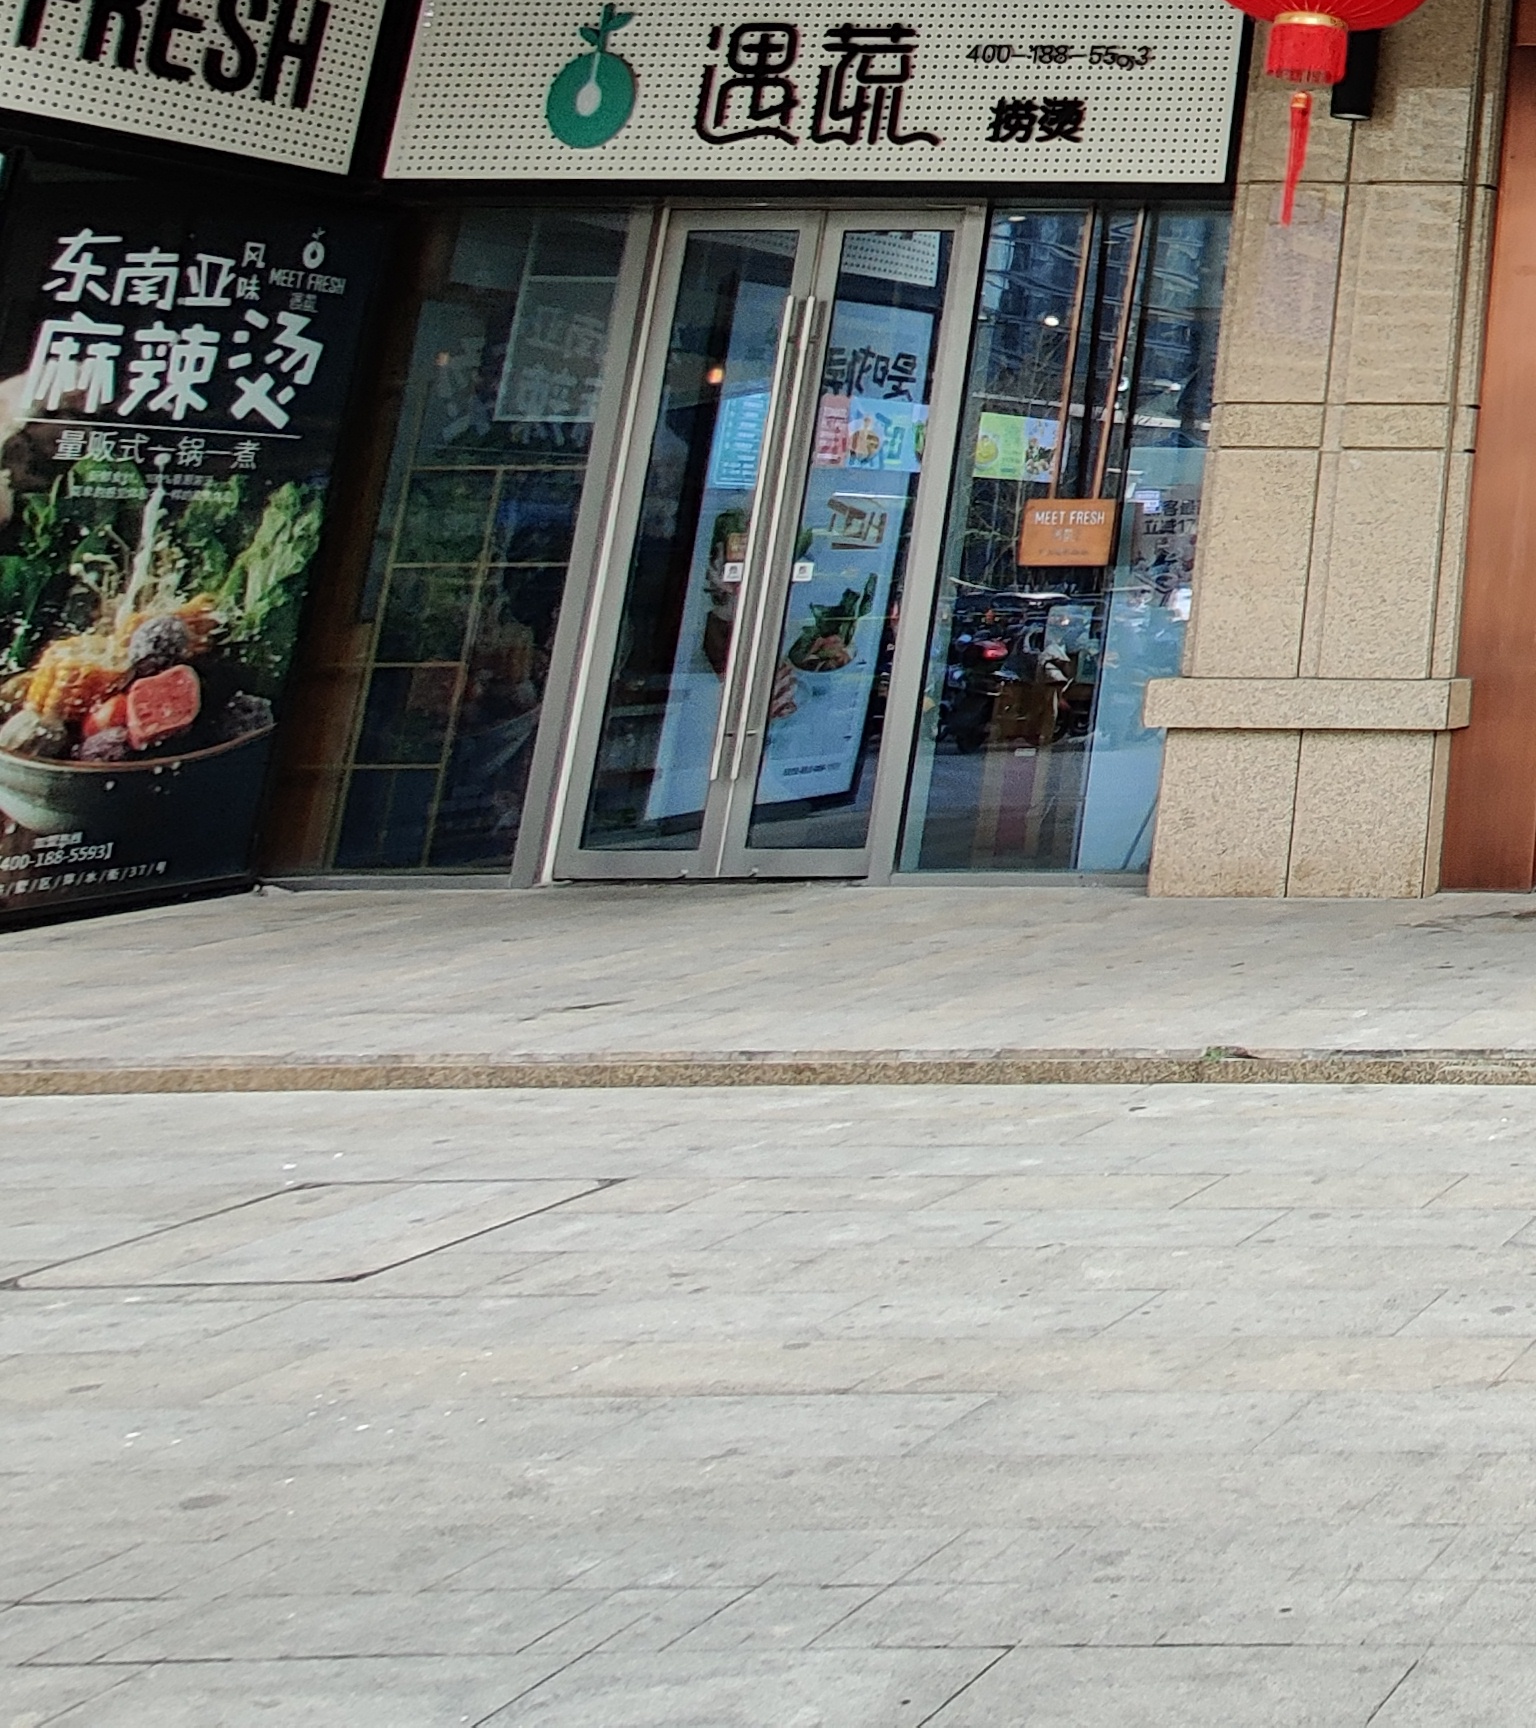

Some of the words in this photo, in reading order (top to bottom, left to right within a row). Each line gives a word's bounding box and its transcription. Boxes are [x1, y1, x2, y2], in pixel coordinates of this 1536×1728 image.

[965, 44, 1155, 71] 400-188-5593
[42, 228, 236, 311] 东南亚
[236, 241, 266, 301] 风味
[20, 310, 325, 431] 麻辣烫
[1034, 510, 1065, 526] MEET
[1069, 510, 1106, 525] FRESH
